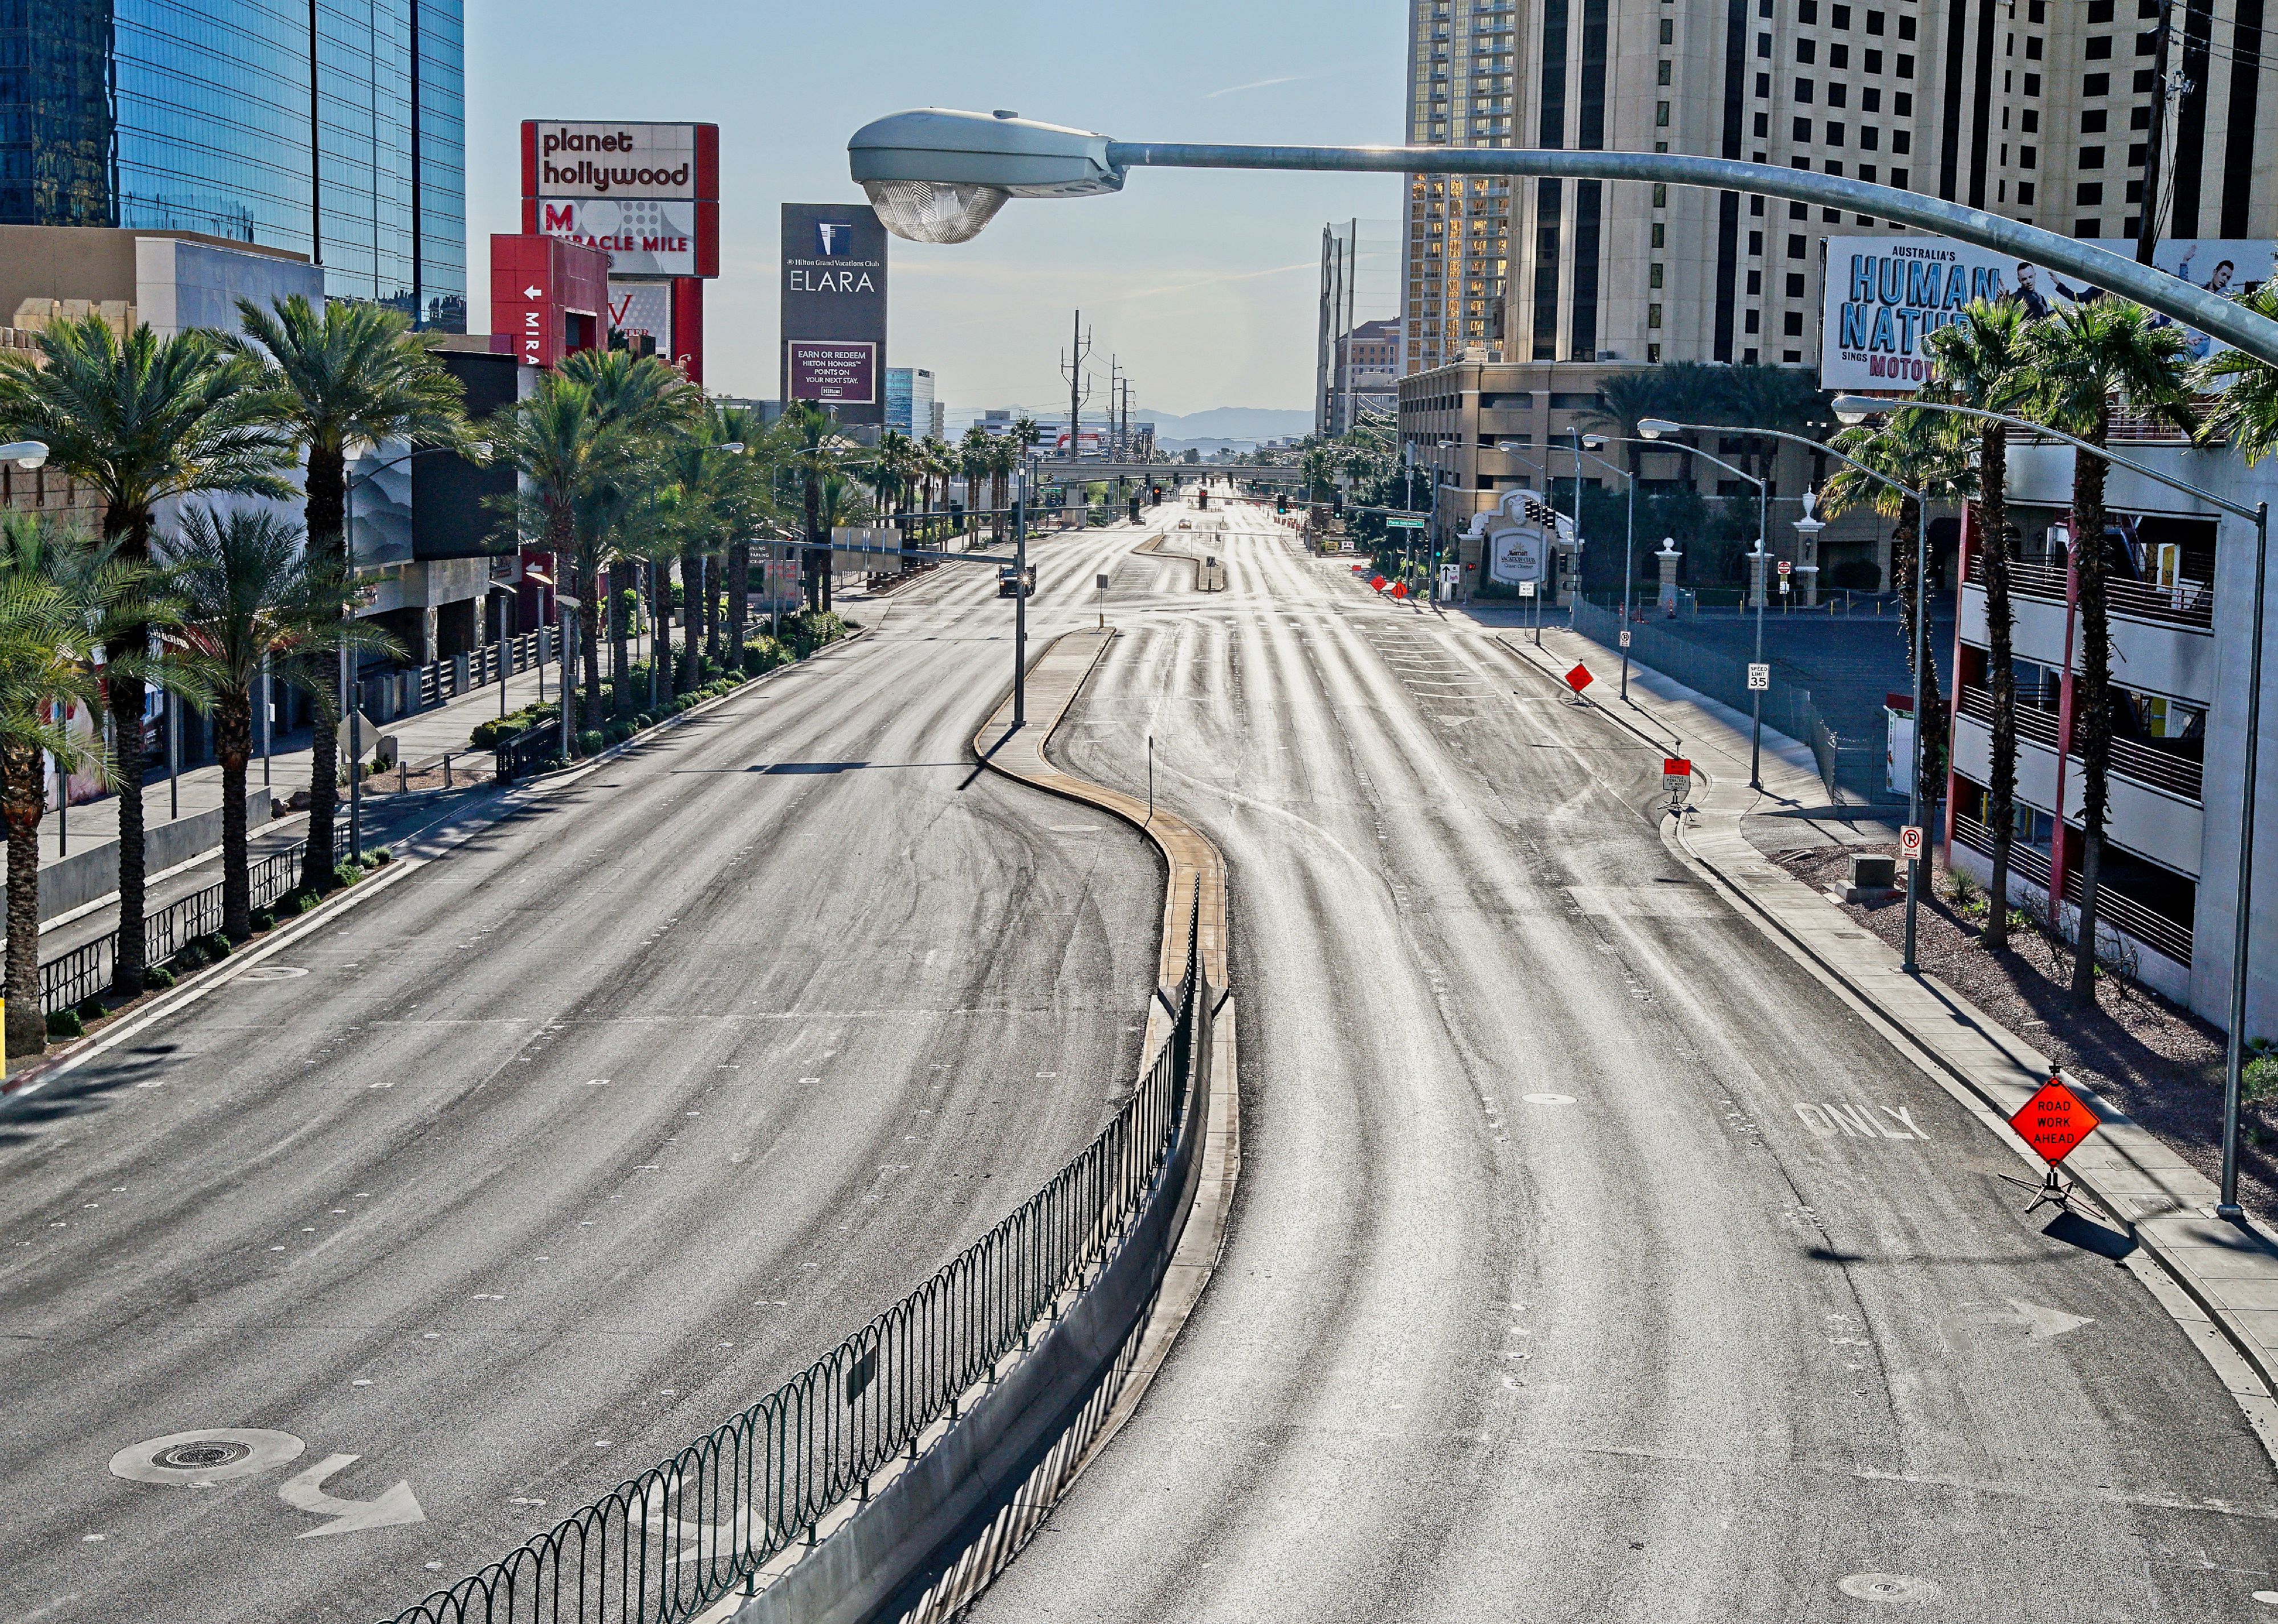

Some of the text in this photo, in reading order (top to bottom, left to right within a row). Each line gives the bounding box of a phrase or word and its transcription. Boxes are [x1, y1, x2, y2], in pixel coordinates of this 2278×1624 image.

[544, 128, 633, 157] planet
[543, 161, 688, 191] hollywood
[557, 235, 687, 252] RACLE MILE
[1892, 246, 1955, 262] AUSTRALIA'S
[790, 270, 875, 292] ELARA
[1850, 254, 2000, 311] HUMAN
[1842, 352, 1868, 362] SINGS
[1750, 677, 1766, 687] 35
[2037, 1101, 2071, 1111] ROAD
[1792, 1102, 1932, 1140] ONLY
[2037, 1117, 2071, 1127] WORK
[2033, 1133, 2075, 1144] AHEAD
